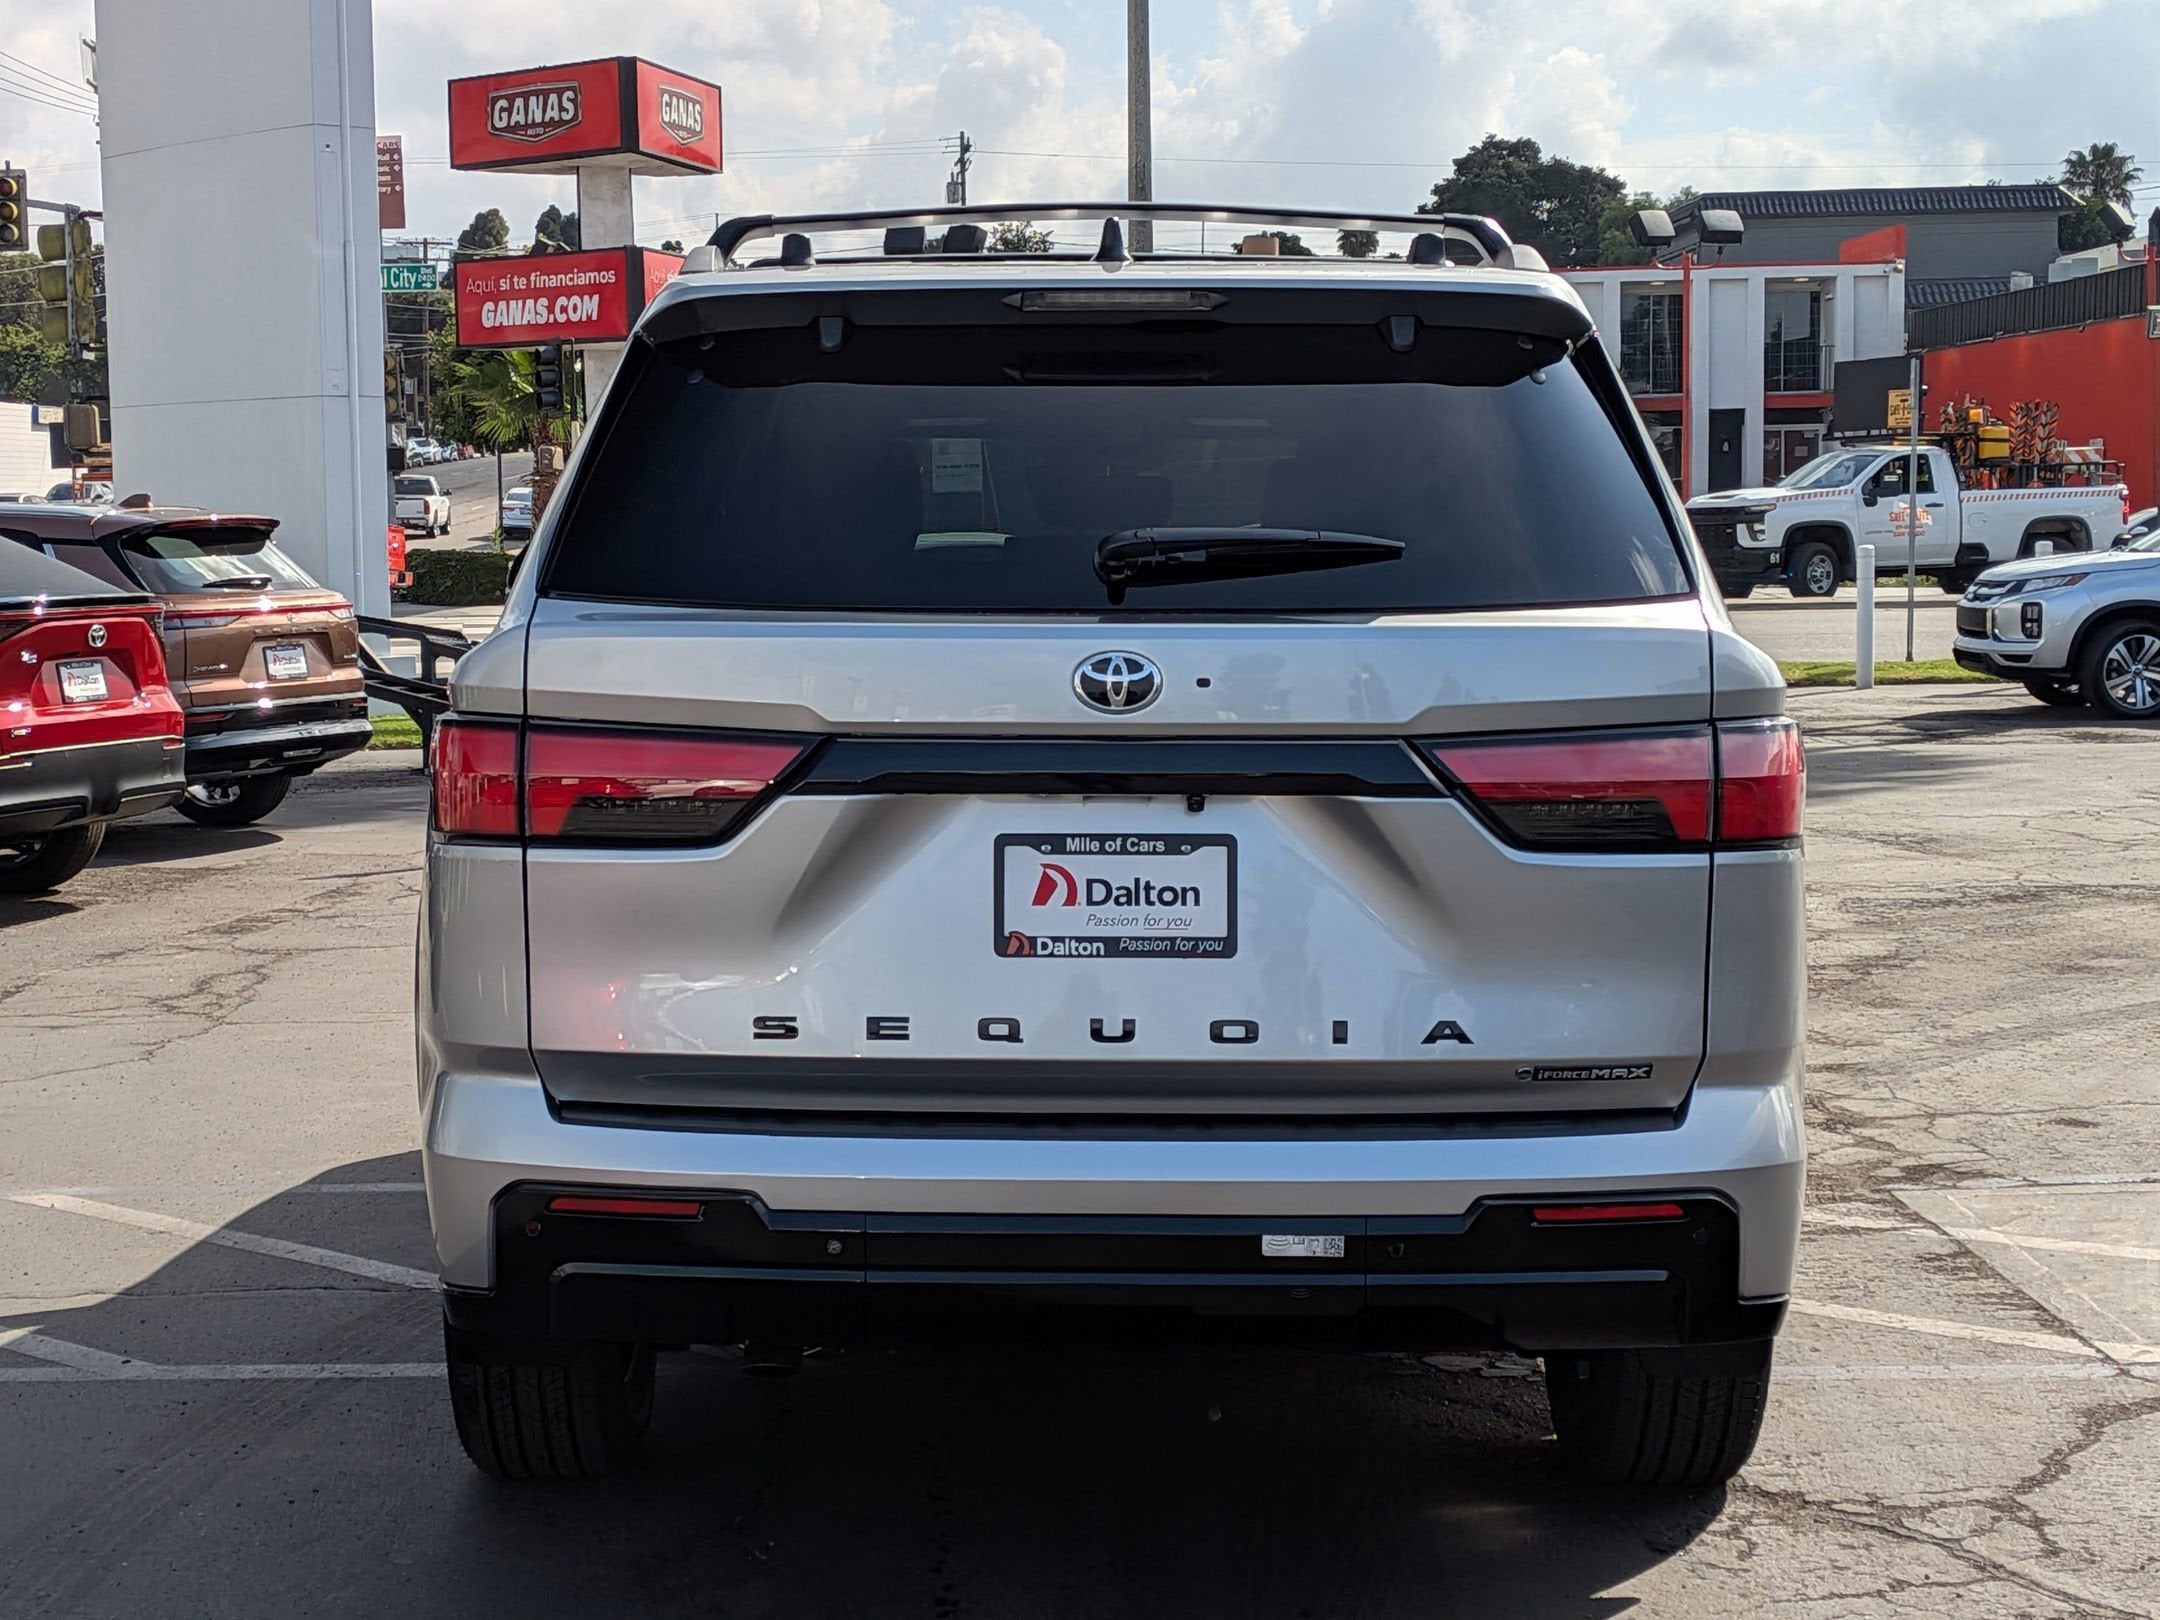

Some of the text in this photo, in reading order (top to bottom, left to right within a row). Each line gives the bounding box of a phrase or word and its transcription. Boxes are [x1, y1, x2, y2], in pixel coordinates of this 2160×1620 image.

[493, 90, 575, 128] GANAS
[662, 93, 701, 132] GANAS
[391, 267, 417, 289] City
[513, 274, 527, 290] te
[530, 268, 616, 290] financiamos
[481, 293, 599, 328] GANAS.COM
[1066, 837, 1166, 852] Mile of Cars
[1085, 877, 1201, 907] Dalton
[1086, 913, 1192, 930] Passion for you
[1036, 937, 1224, 956] Dalton Passion for you
[752, 1015, 1475, 1045] SEQUOIA
